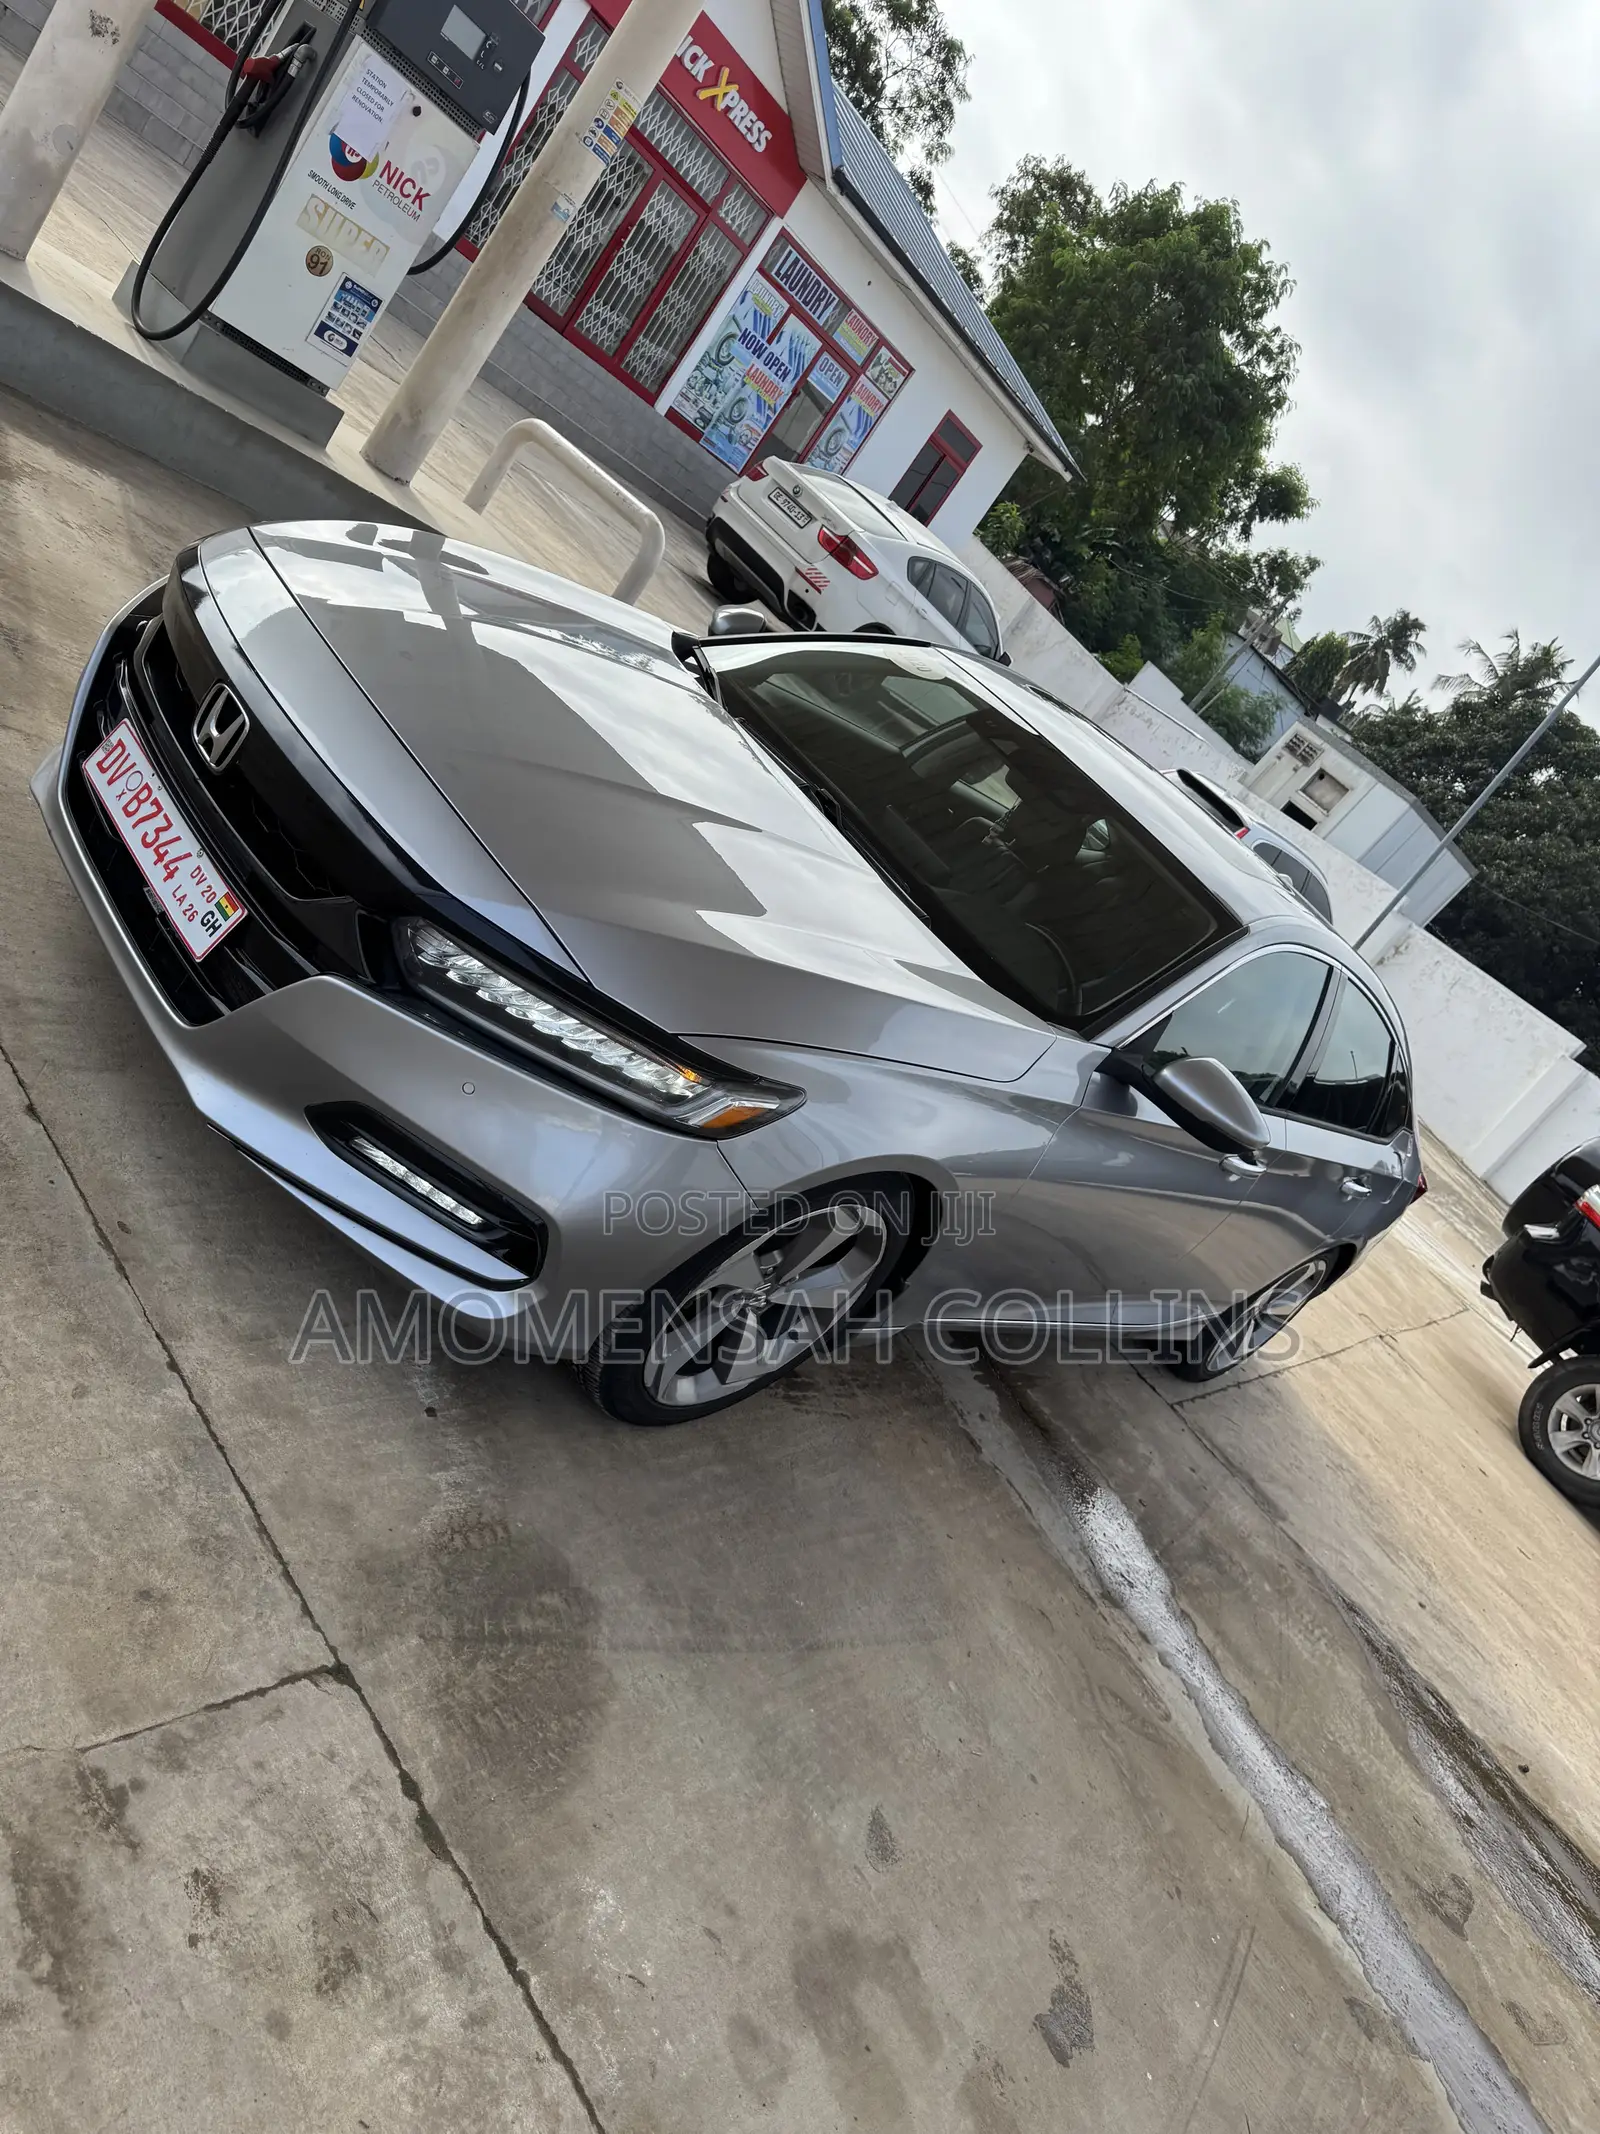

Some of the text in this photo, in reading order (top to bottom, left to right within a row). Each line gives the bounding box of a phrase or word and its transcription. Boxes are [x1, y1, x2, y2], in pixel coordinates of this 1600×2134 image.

[361, 77, 395, 107] TEMPORARILY
[366, 68, 388, 89] STATION
[676, 35, 773, 153] ICK XPRESS
[356, 86, 385, 113] CLOSED FOR
[307, 169, 357, 210] SMOOTH LONG DRIVE
[372, 180, 421, 222] PETROLEUM
[379, 159, 431, 212] NICK
[307, 253, 328, 275] 91
[315, 248, 331, 261] RON
[747, 278, 785, 319] LAUNDRY
[774, 248, 837, 320] LAUNDRY
[845, 311, 877, 348] LAUNDRY
[738, 327, 792, 383] NOW OPEN
[818, 356, 846, 388] OPEN
[745, 363, 784, 401] LAUNDRY
[852, 383, 884, 412] LAUNDRY
[96, 738, 193, 883] DV B7344
[189, 864, 217, 904] DV 20
[171, 884, 199, 923] LA 26
[200, 910, 223, 938] GH
